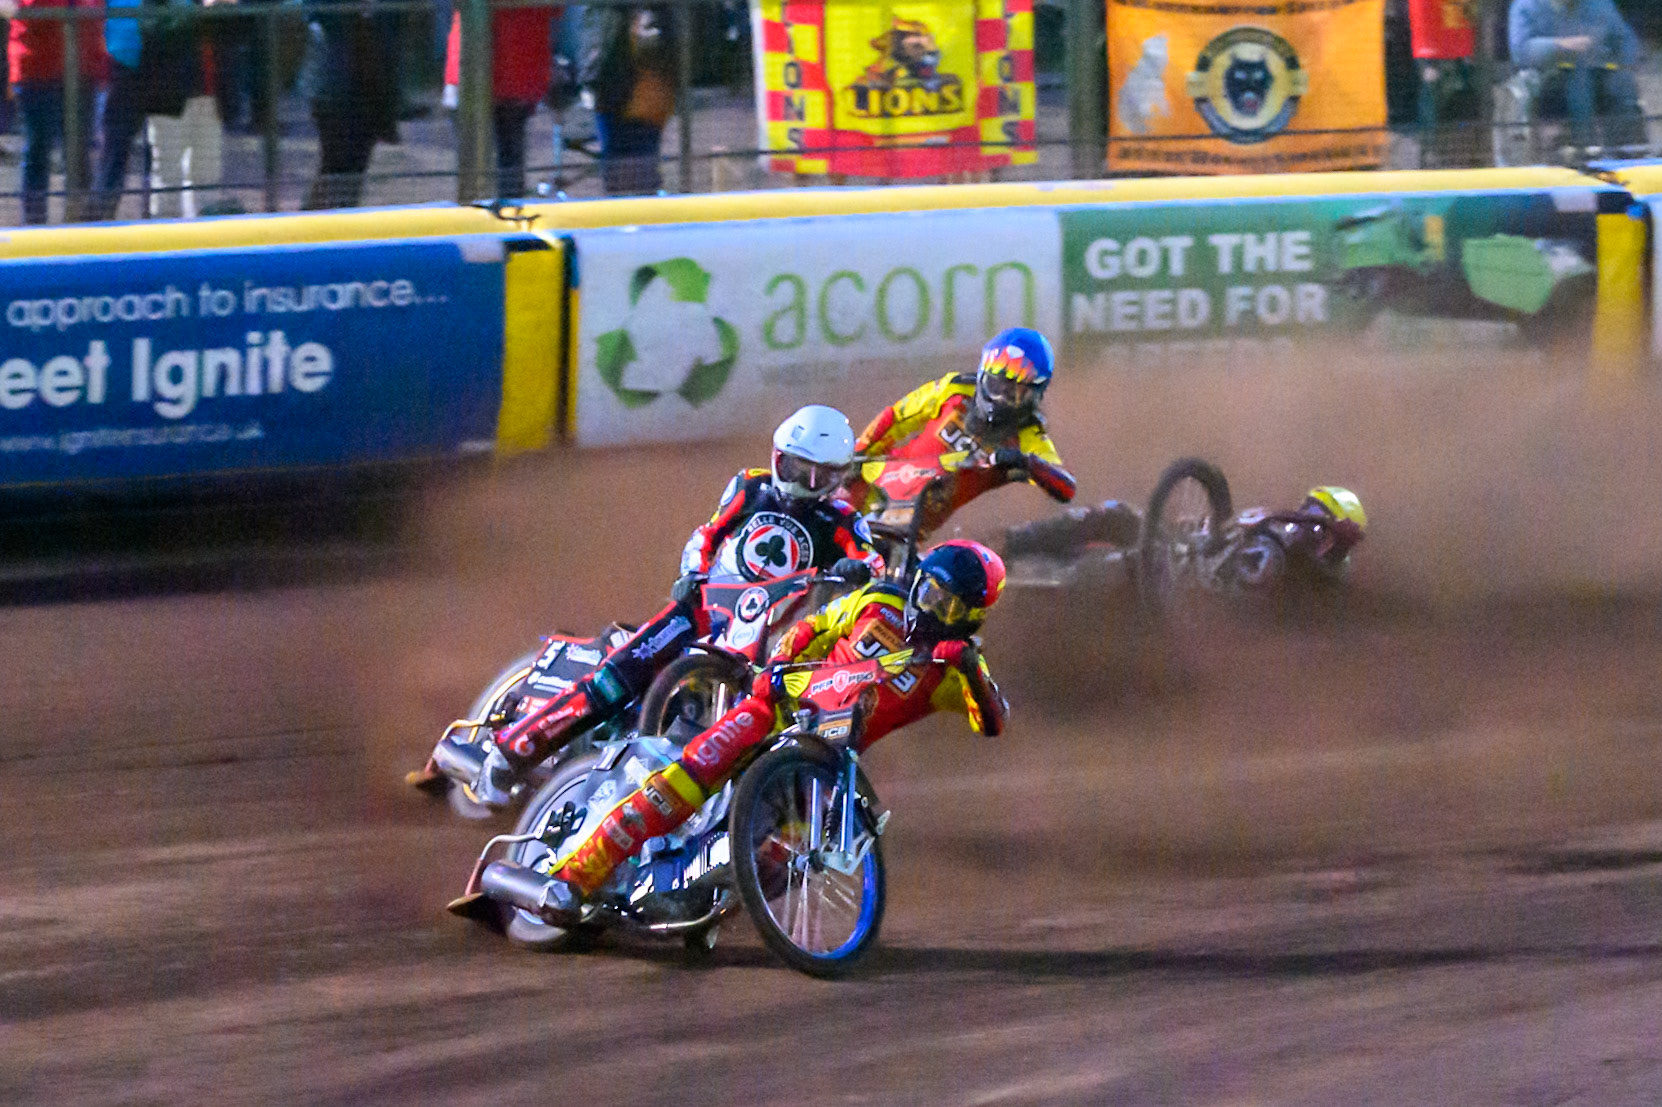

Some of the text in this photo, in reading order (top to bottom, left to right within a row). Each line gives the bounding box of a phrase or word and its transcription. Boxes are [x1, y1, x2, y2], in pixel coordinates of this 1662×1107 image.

[845, 84, 963, 116] LIONS
[1084, 230, 1313, 280] GOT THE
[6, 284, 191, 332] approach
[198, 281, 237, 317] to
[762, 262, 1037, 351] acorn
[1070, 282, 1329, 333] NEED FOR
[131, 329, 334, 419] Ignite
[822, 726, 848, 739] JCB
